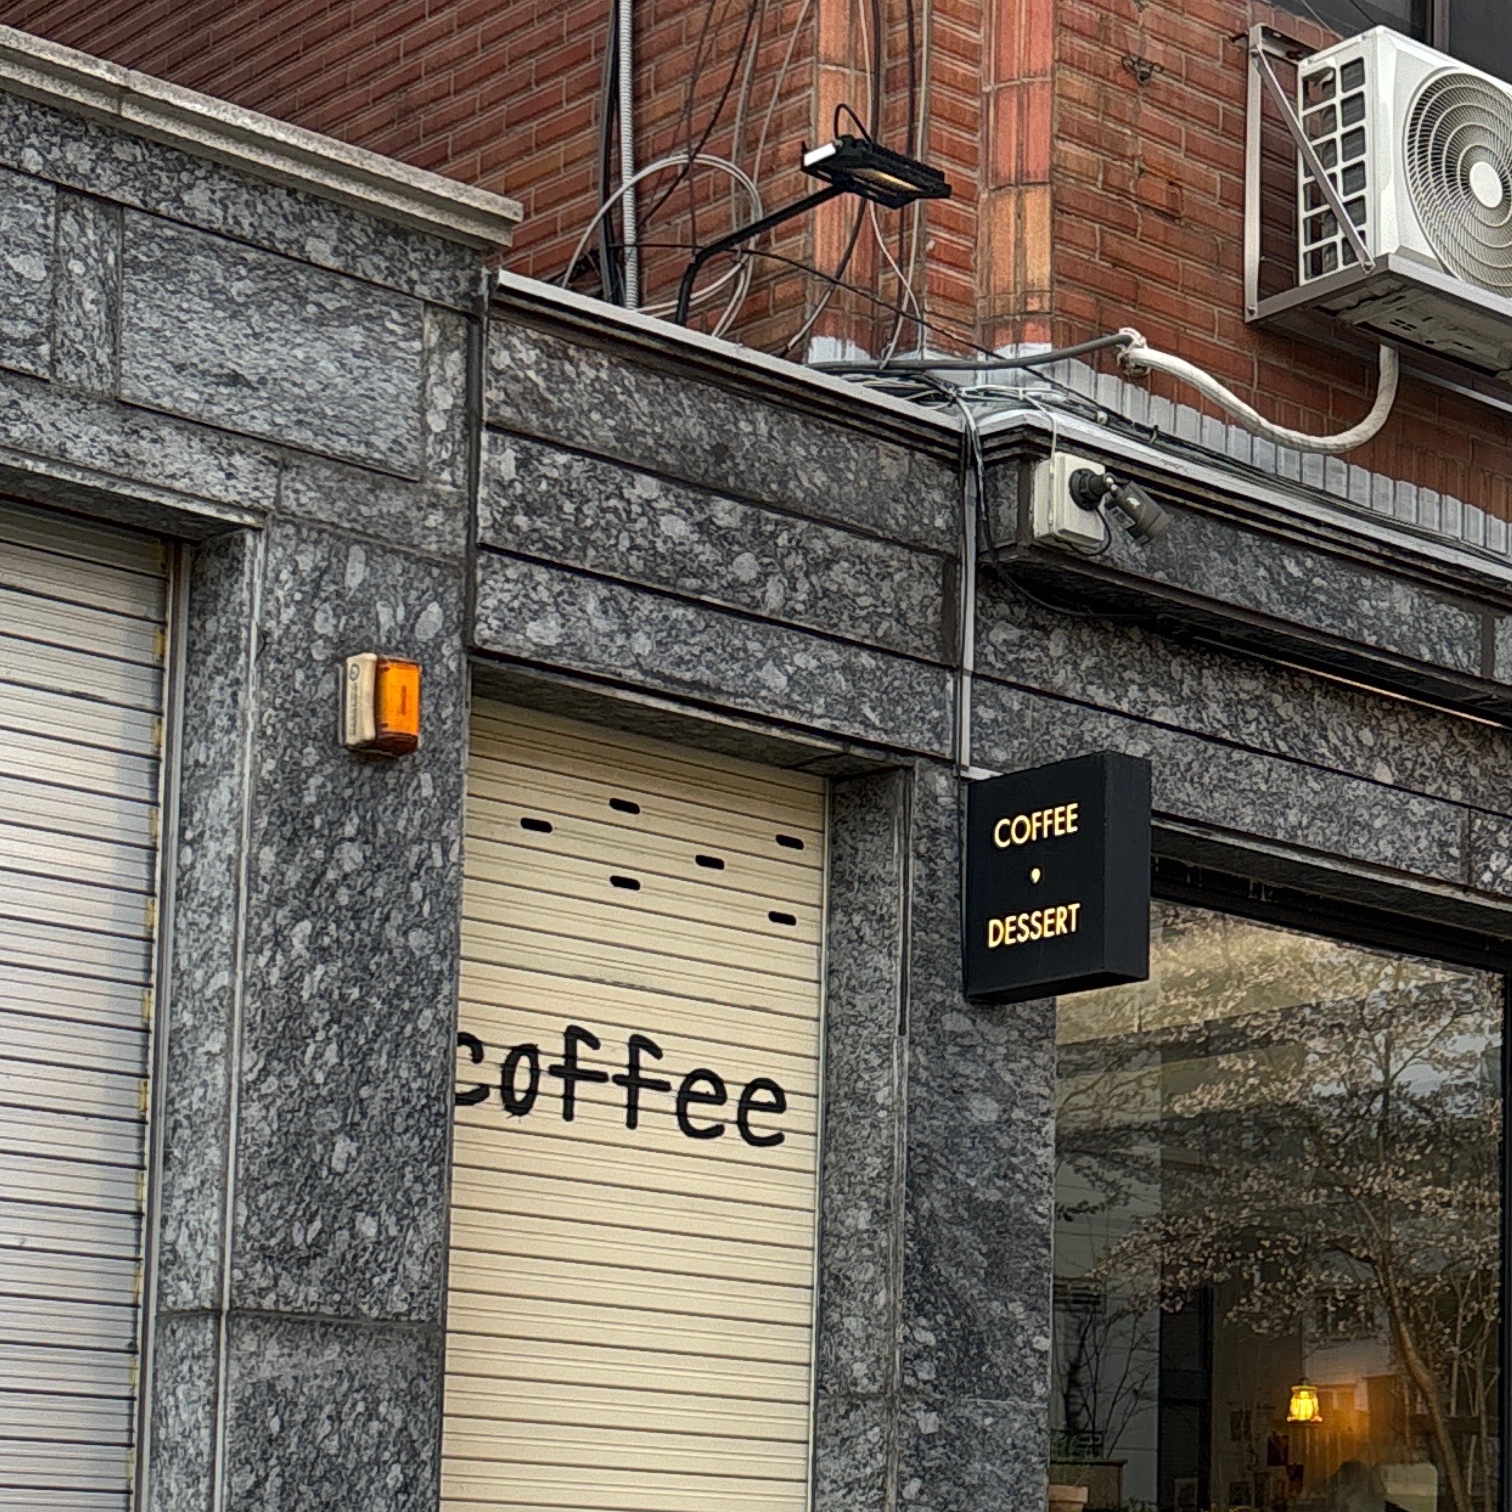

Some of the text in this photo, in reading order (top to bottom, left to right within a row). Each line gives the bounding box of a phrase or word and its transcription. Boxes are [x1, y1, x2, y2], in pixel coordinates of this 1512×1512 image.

[994, 803, 1078, 848] COFFEE
[988, 903, 1080, 948] DESSERT
[455, 1024, 787, 1147] coffee
